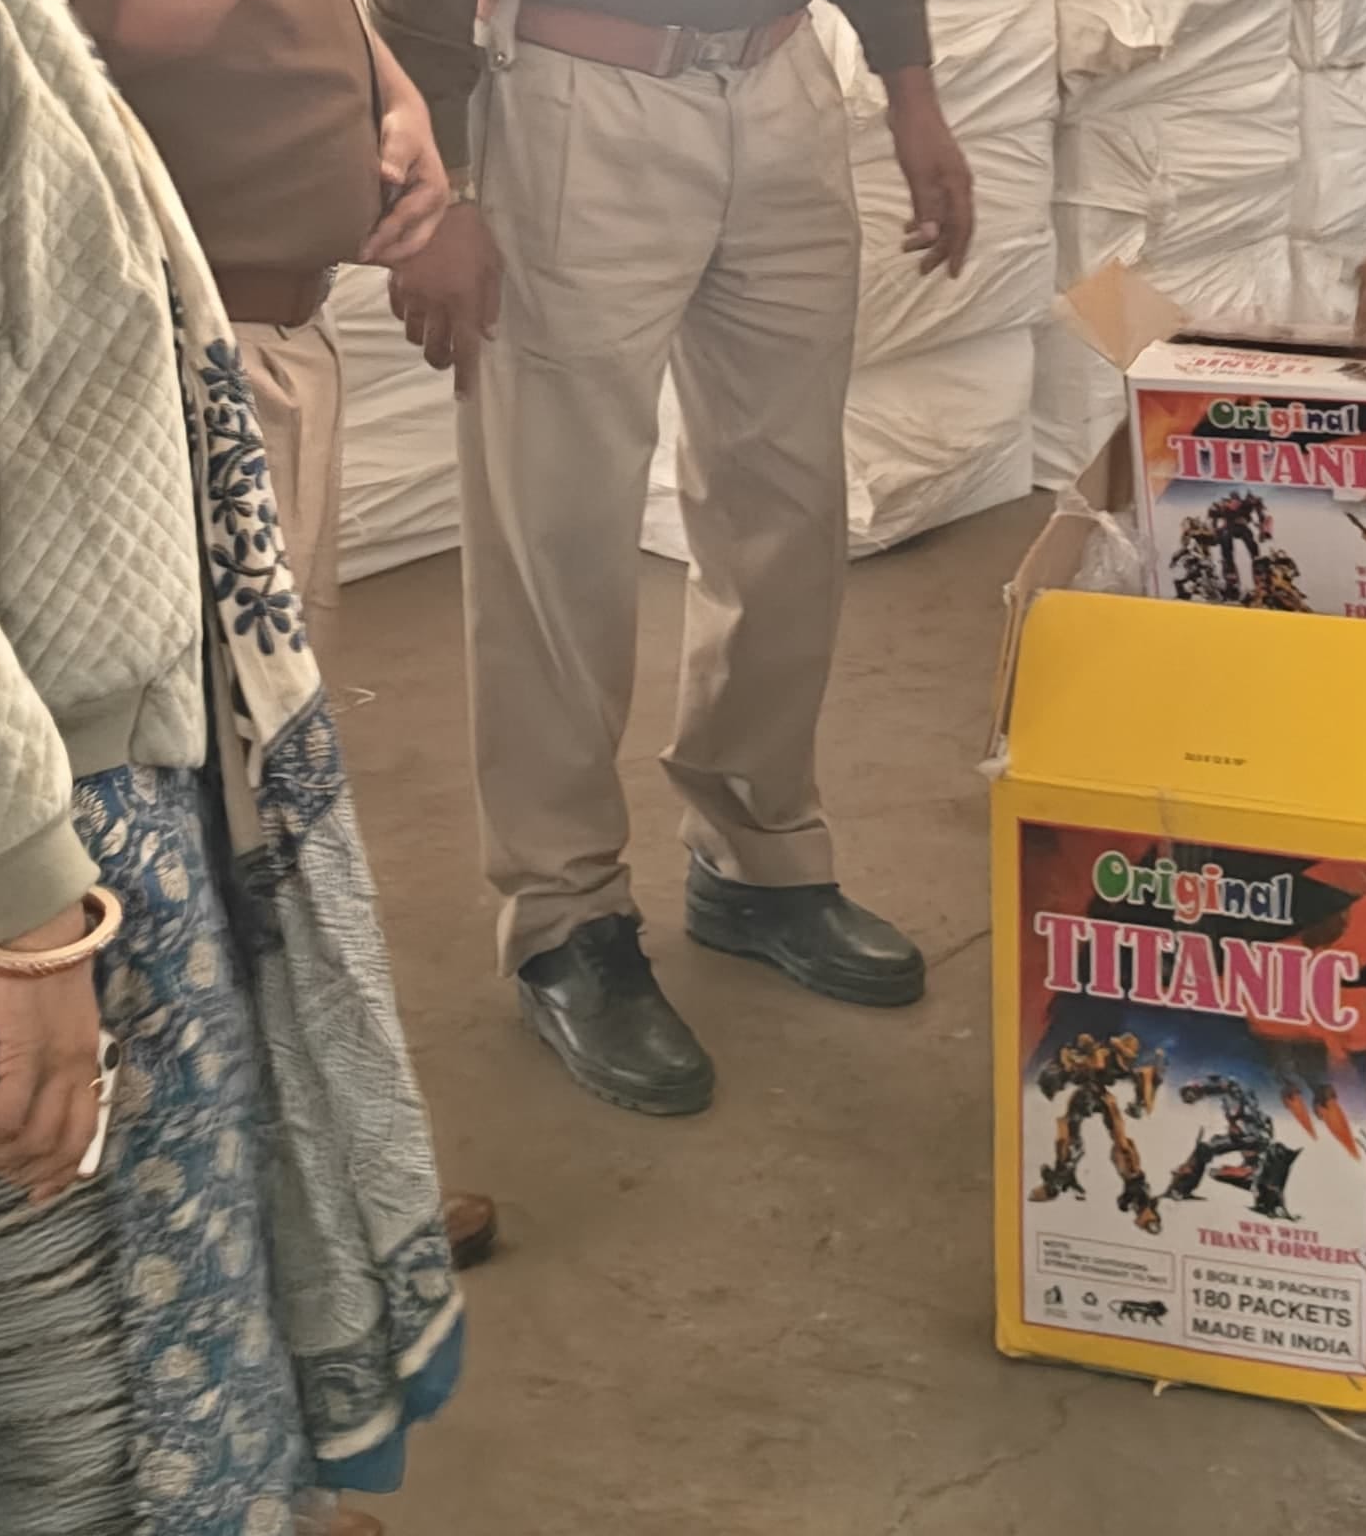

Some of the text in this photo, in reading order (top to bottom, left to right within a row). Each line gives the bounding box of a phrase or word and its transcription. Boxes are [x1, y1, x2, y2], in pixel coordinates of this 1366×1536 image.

[1209, 399, 1359, 436] Original
[1093, 850, 1293, 925] Original
[1035, 911, 1360, 1031] TITANIC
[1197, 1228, 1362, 1264] TRANS FORMERS
[1239, 1221, 1272, 1235] WIN
[1192, 1268, 1203, 1280] 6
[1206, 1269, 1238, 1285] BOX
[1243, 1276, 1253, 1287] X
[1278, 1280, 1351, 1301] PACKETS
[1192, 1287, 1352, 1328] 180 PACKETS
[1192, 1317, 1353, 1356] MADE IN INDIA
